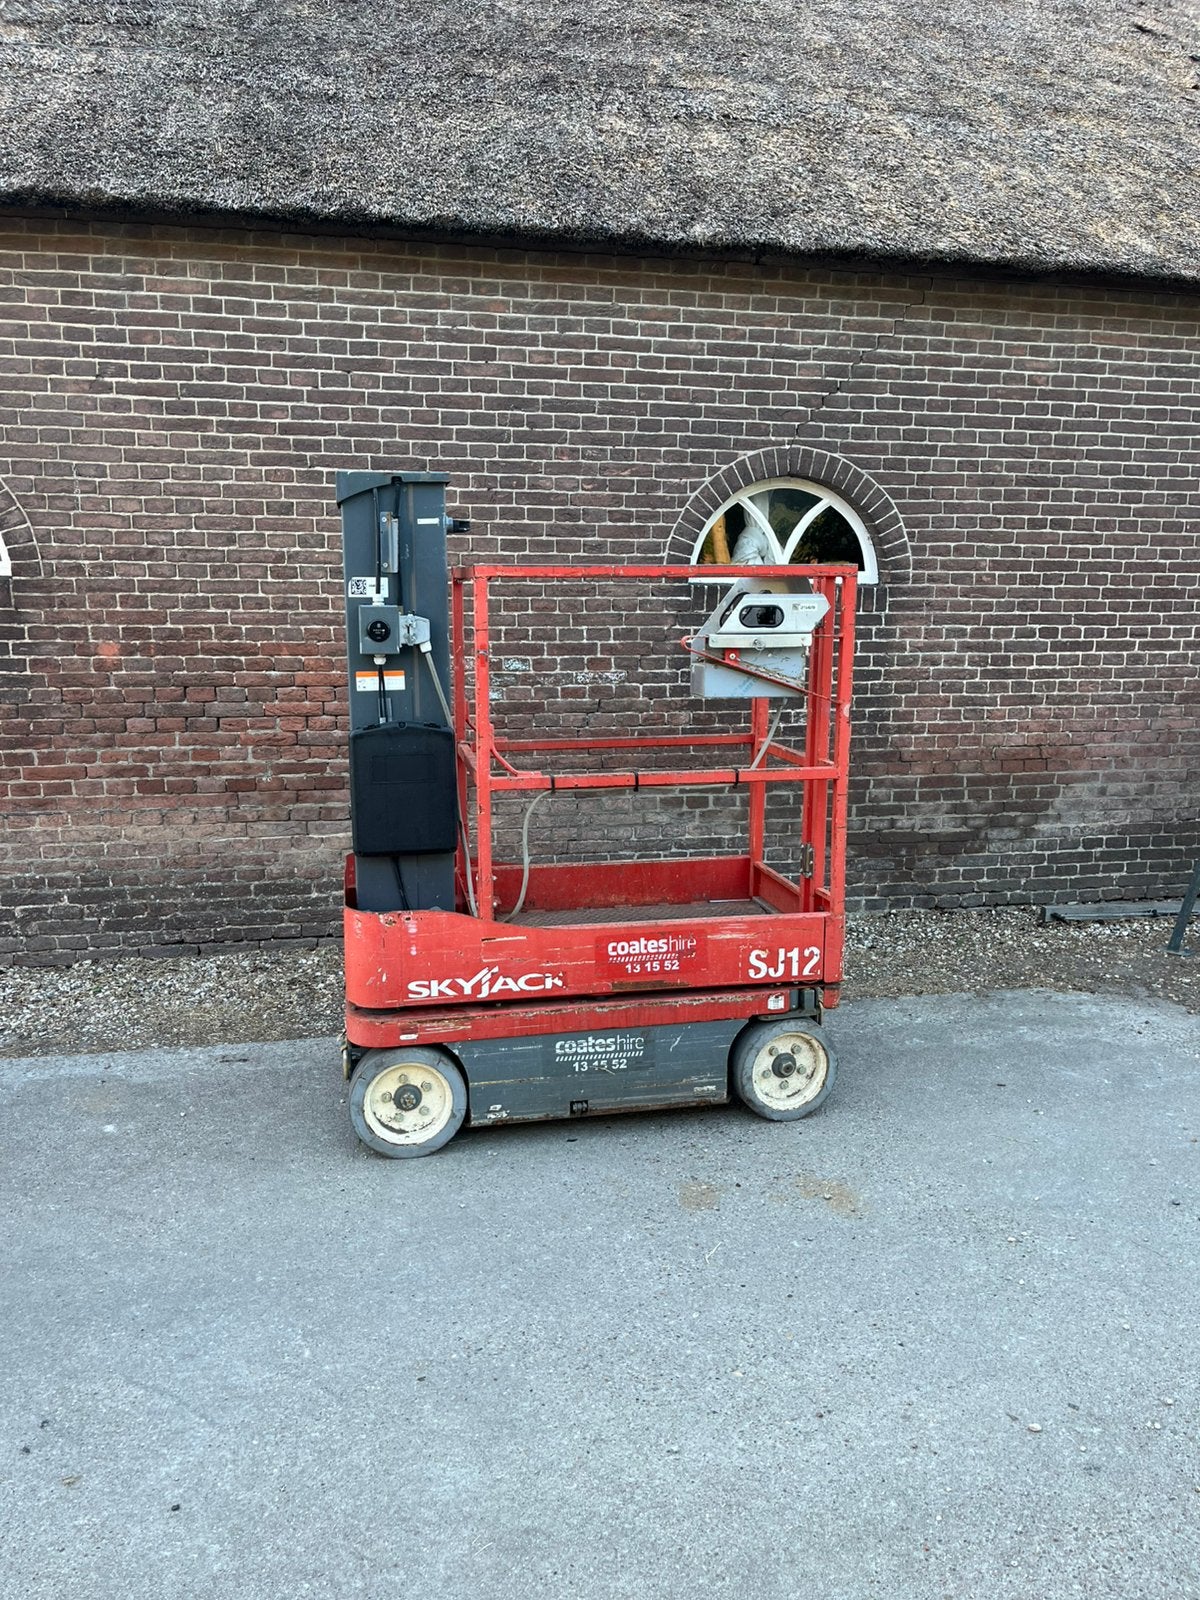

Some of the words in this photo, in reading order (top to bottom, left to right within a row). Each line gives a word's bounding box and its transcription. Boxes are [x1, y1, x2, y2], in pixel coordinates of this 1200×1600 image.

[625, 962, 641, 974] 13
[645, 960, 660, 972] 15
[664, 959, 680, 971] 52
[748, 946, 821, 979] SJ12
[407, 965, 566, 998] SKYJACK
[573, 1061, 589, 1072] 13
[592, 1059, 608, 1071] 15
[611, 1058, 628, 1070] 52
